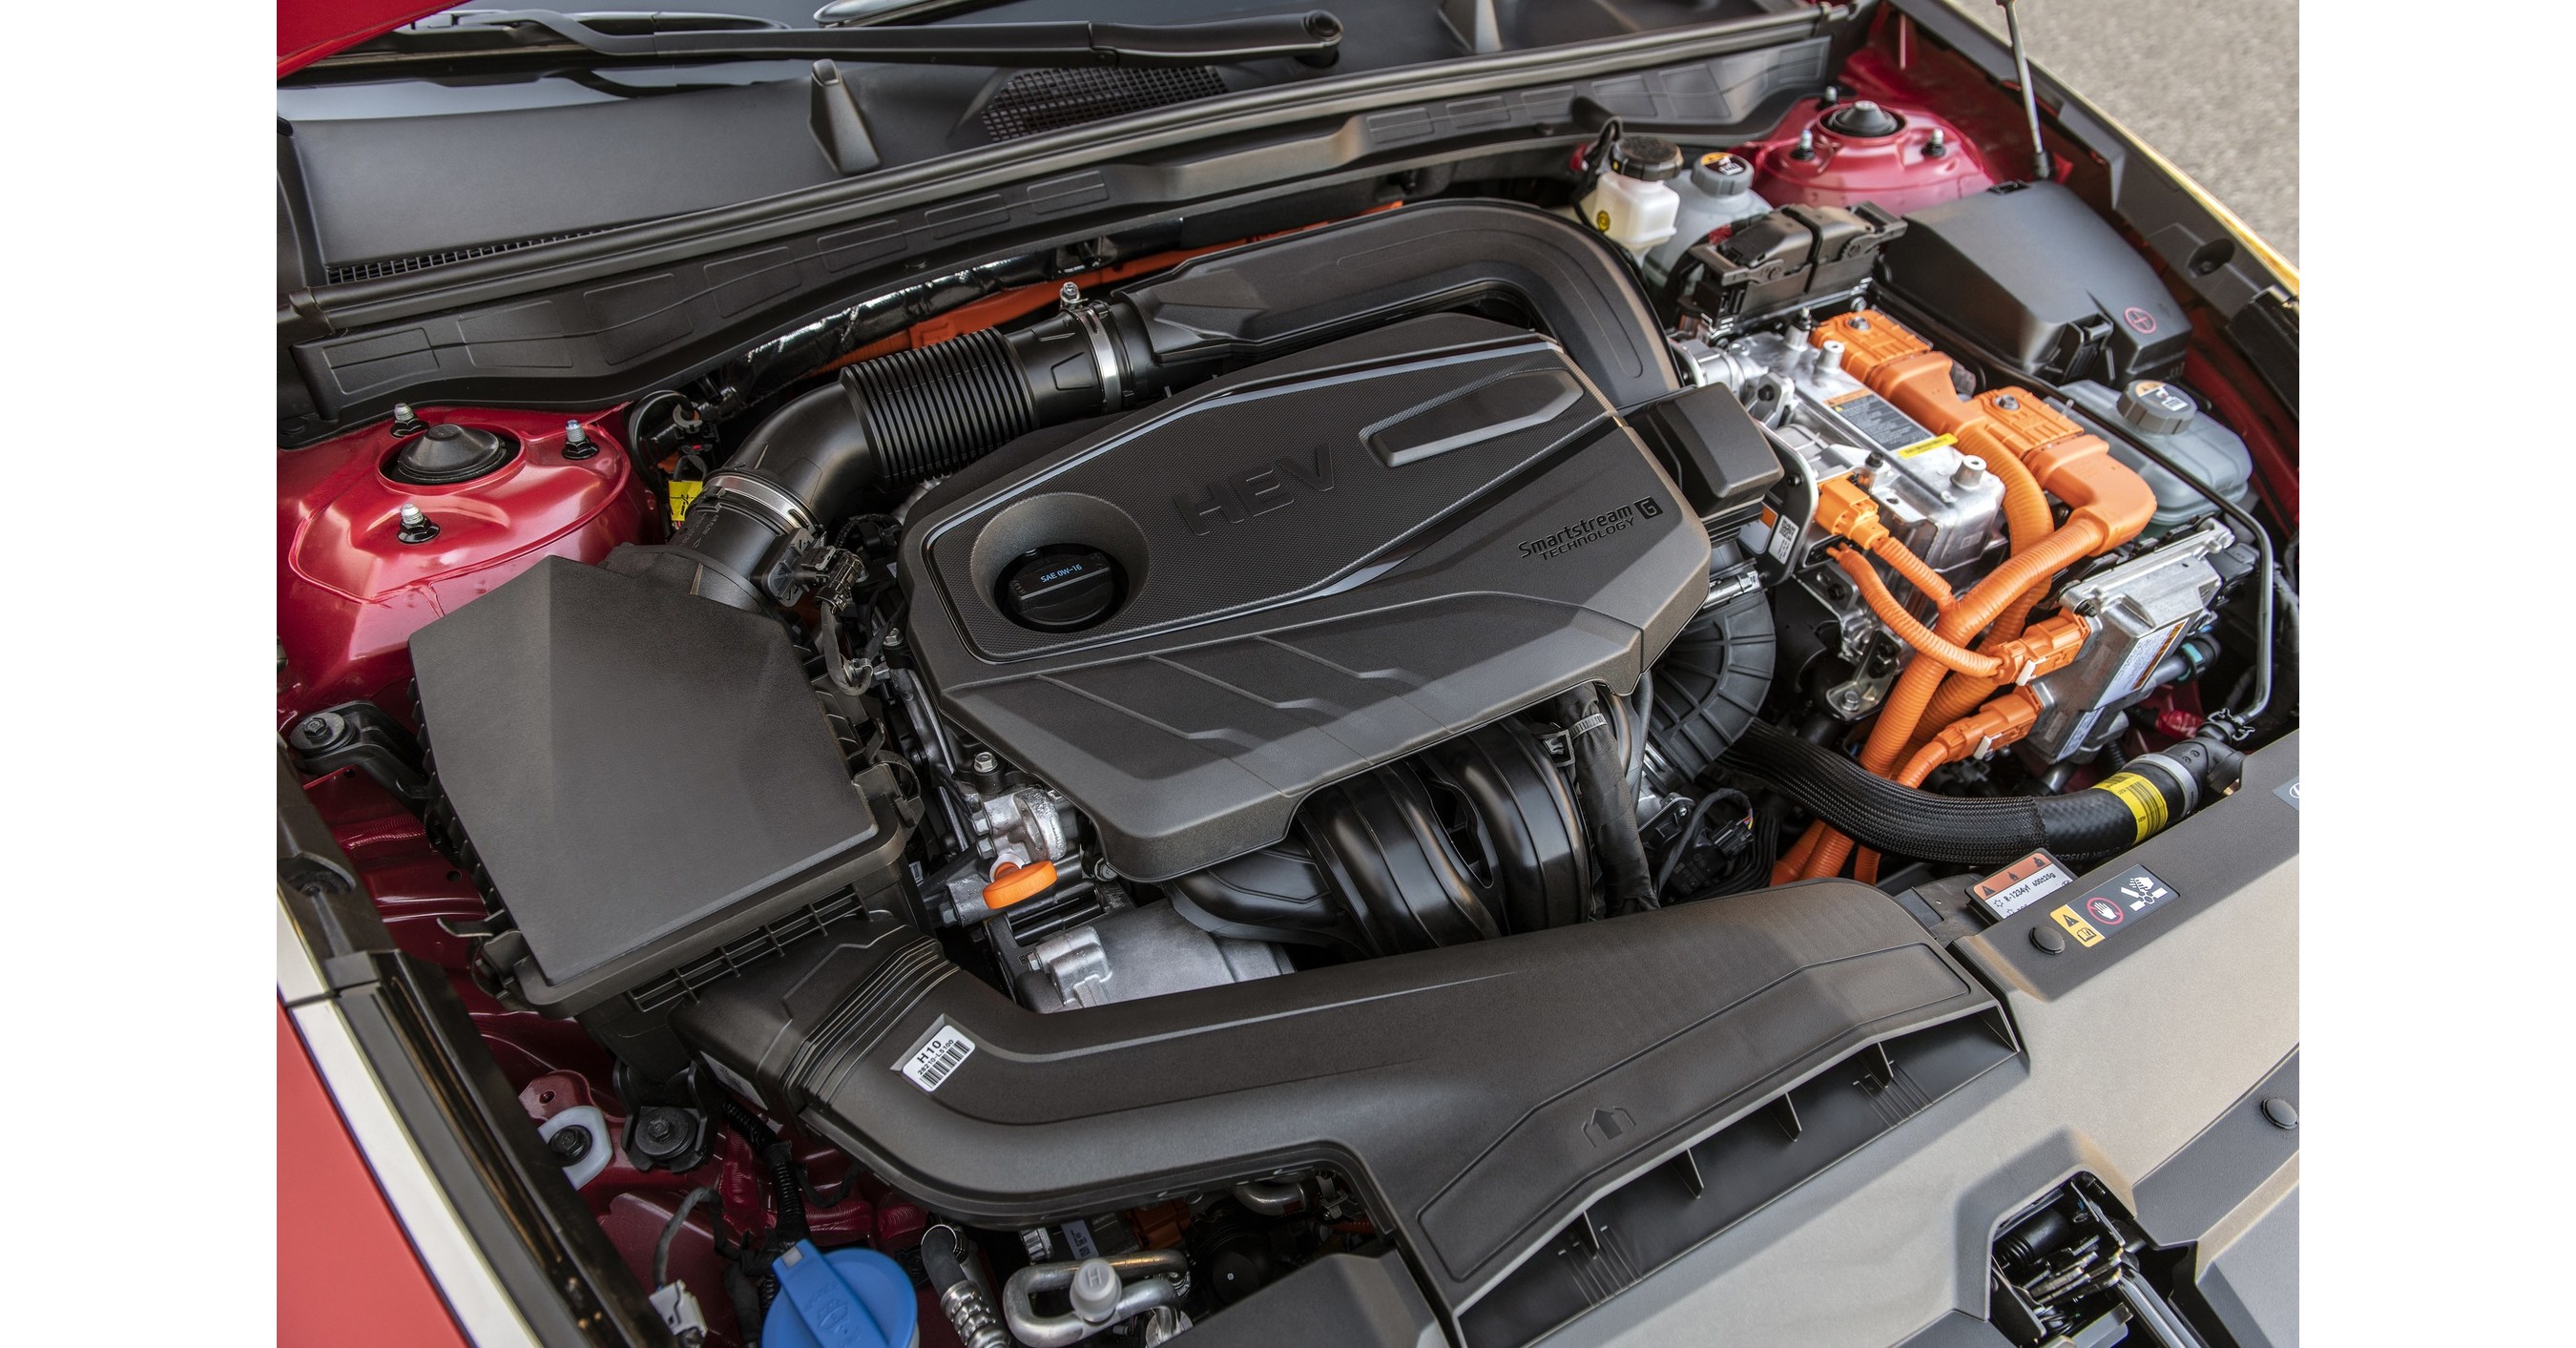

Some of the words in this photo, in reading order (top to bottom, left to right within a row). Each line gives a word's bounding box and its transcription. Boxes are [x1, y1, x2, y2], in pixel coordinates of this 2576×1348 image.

[1174, 445, 1338, 537] HEV
[1518, 506, 1632, 558] Smartstream
[1637, 498, 1661, 518] G
[1539, 516, 1634, 560] TECHNOLOGY
[1041, 572, 1057, 583] SAE
[1057, 564, 1083, 576] 0W-16
[2004, 884, 2031, 902] R-1234yf
[917, 1040, 942, 1065] H10
[918, 1040, 954, 1075] 28210-L5100
[1087, 1267, 1102, 1287] H
